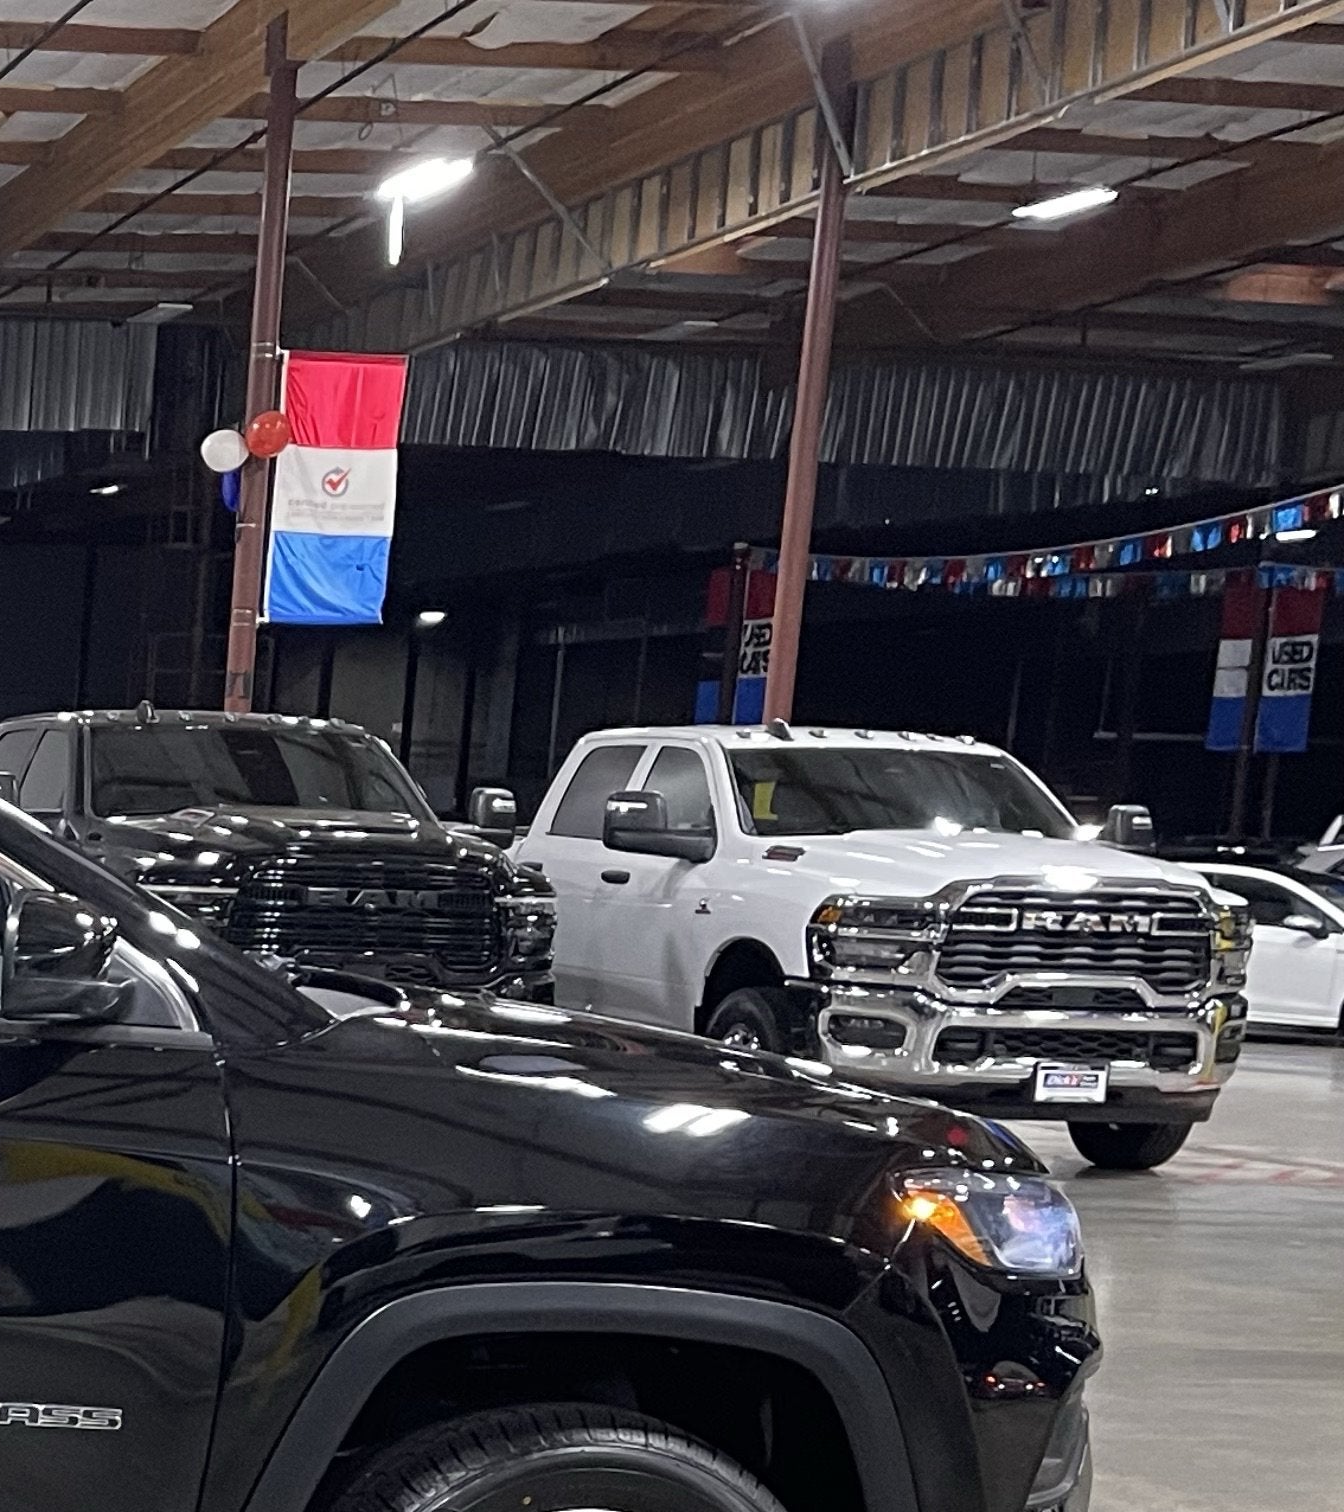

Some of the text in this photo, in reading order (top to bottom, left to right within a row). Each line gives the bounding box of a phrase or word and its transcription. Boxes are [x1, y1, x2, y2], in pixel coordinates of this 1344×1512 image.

[1272, 641, 1313, 665] USED
[1267, 667, 1313, 692] CARS
[1022, 911, 1151, 933] RAM
